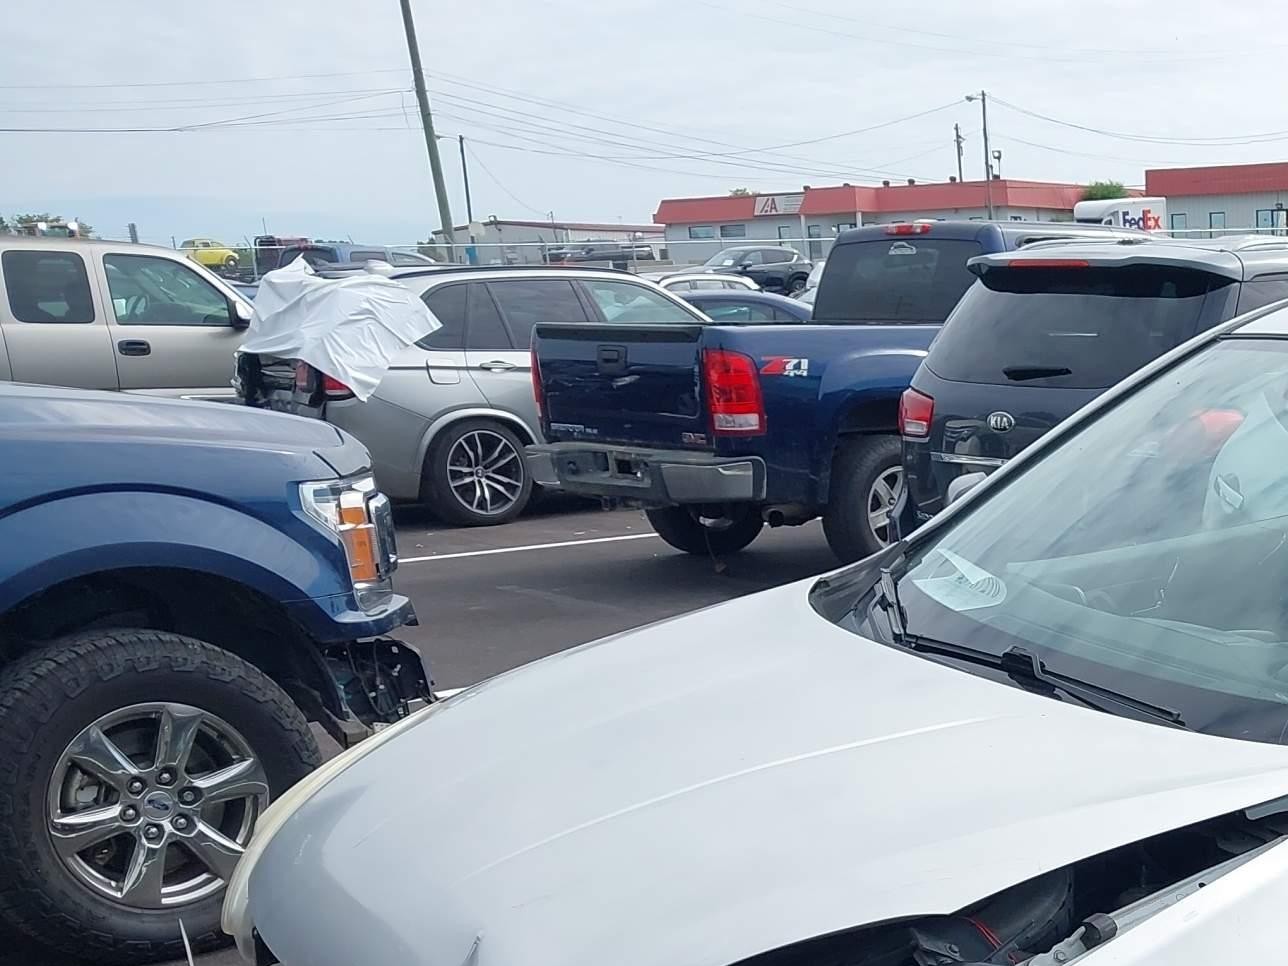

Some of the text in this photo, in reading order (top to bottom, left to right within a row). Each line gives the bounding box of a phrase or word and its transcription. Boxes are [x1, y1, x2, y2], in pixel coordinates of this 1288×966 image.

[1121, 209, 1162, 231] FedEx
[760, 356, 809, 375] Z71
[990, 415, 1010, 430] KIA
